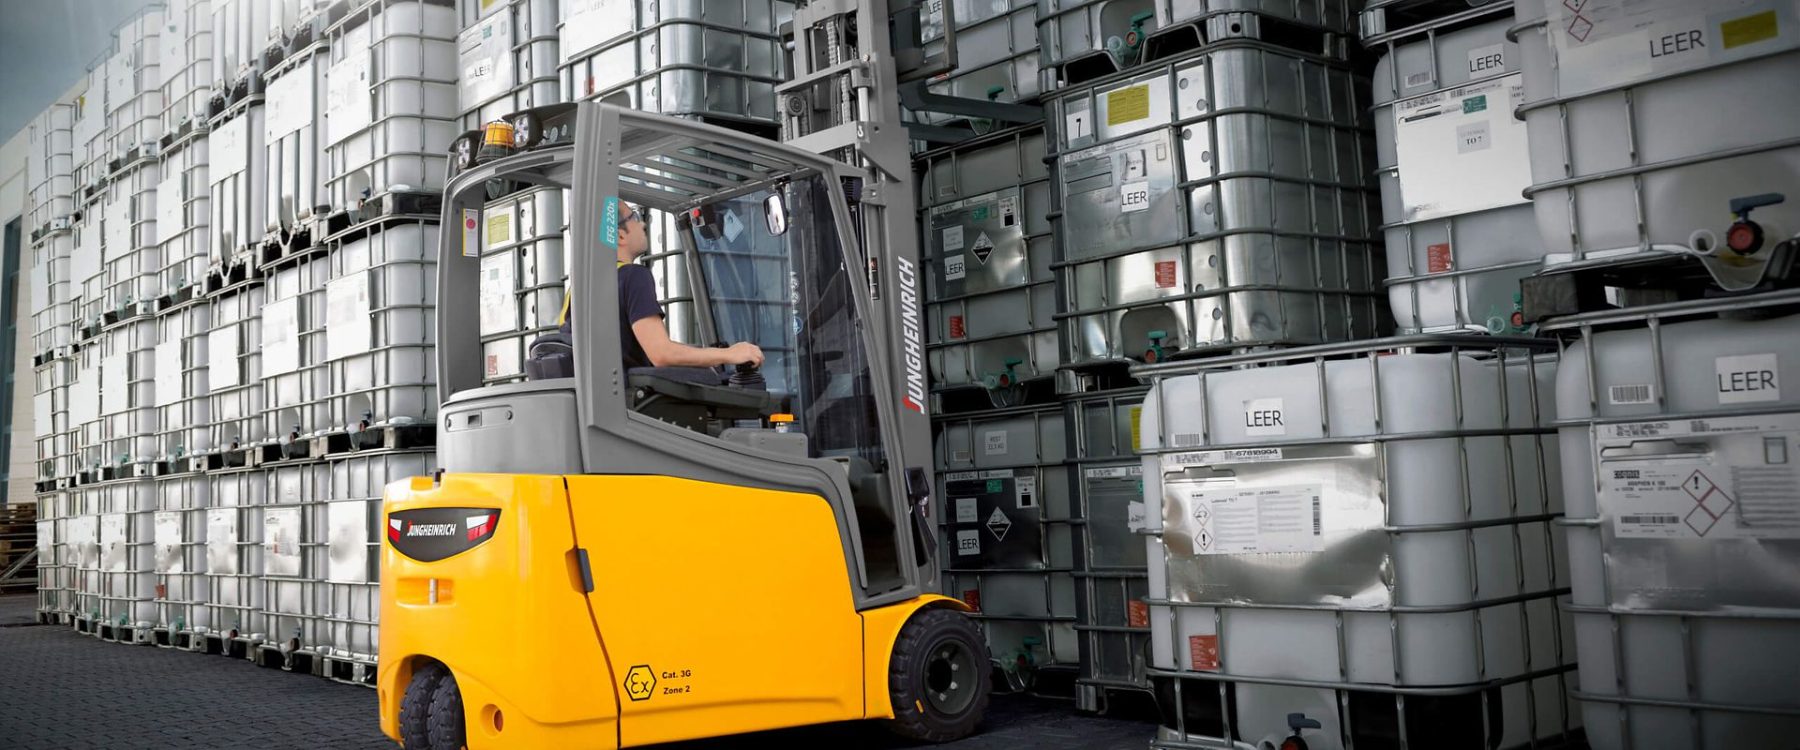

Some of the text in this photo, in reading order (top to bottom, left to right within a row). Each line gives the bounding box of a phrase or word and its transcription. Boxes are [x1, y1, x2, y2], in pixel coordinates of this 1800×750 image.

[1649, 29, 1705, 58] LEER
[1469, 53, 1503, 72] LEER
[1121, 190, 1148, 206] LEER
[606, 200, 615, 244] EFG 220x
[945, 262, 964, 276] LEER
[898, 255, 925, 415] JUNGHEINRICH
[1718, 369, 1777, 393] LEER
[1245, 410, 1284, 427] LEER
[407, 520, 457, 537] JUNGHEINRICH
[959, 537, 979, 550] LEER
[662, 669, 692, 679] Cat. 3G
[663, 684, 691, 695] Zone 2
